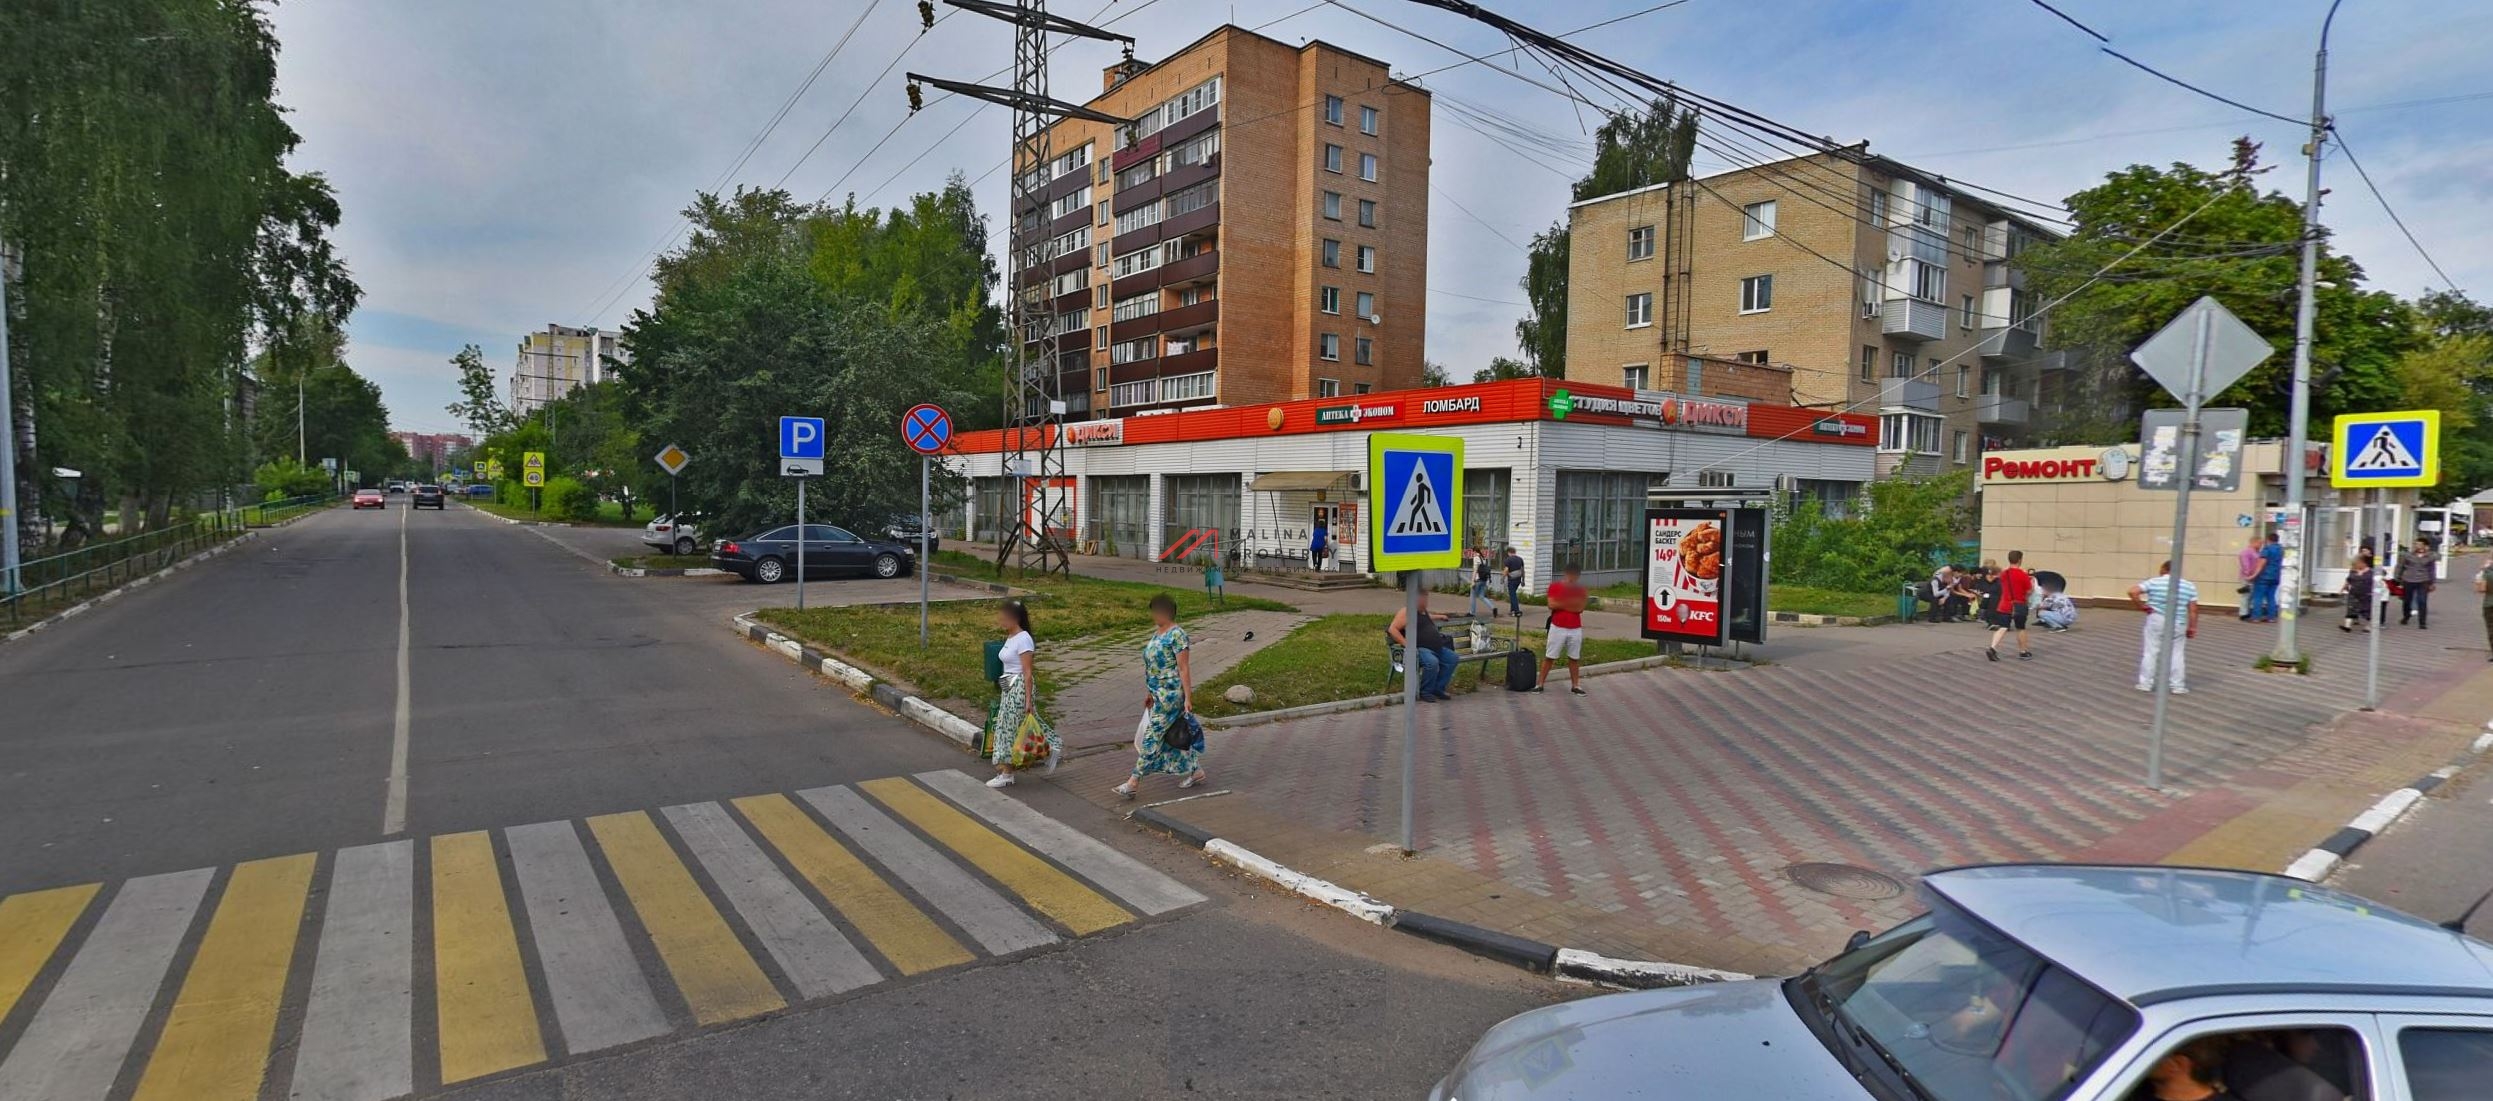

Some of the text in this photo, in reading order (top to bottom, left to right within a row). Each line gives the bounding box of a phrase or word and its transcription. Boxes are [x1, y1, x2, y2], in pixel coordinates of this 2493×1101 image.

[1423, 396, 1480, 413] ЛОМБАРД
[1618, 400, 1662, 416] ЦВЕТОВ
[1321, 405, 1394, 421] АПТЕКА ЭКОНОМ
[1682, 401, 1746, 427] ДИКСИ
[792, 421, 816, 454] P
[1984, 457, 2096, 479] Ремонт
[1655, 530, 1682, 538] САНДЕРС
[1655, 537, 1677, 545] БАСКЕТ
[1689, 610, 1714, 622] KFC
